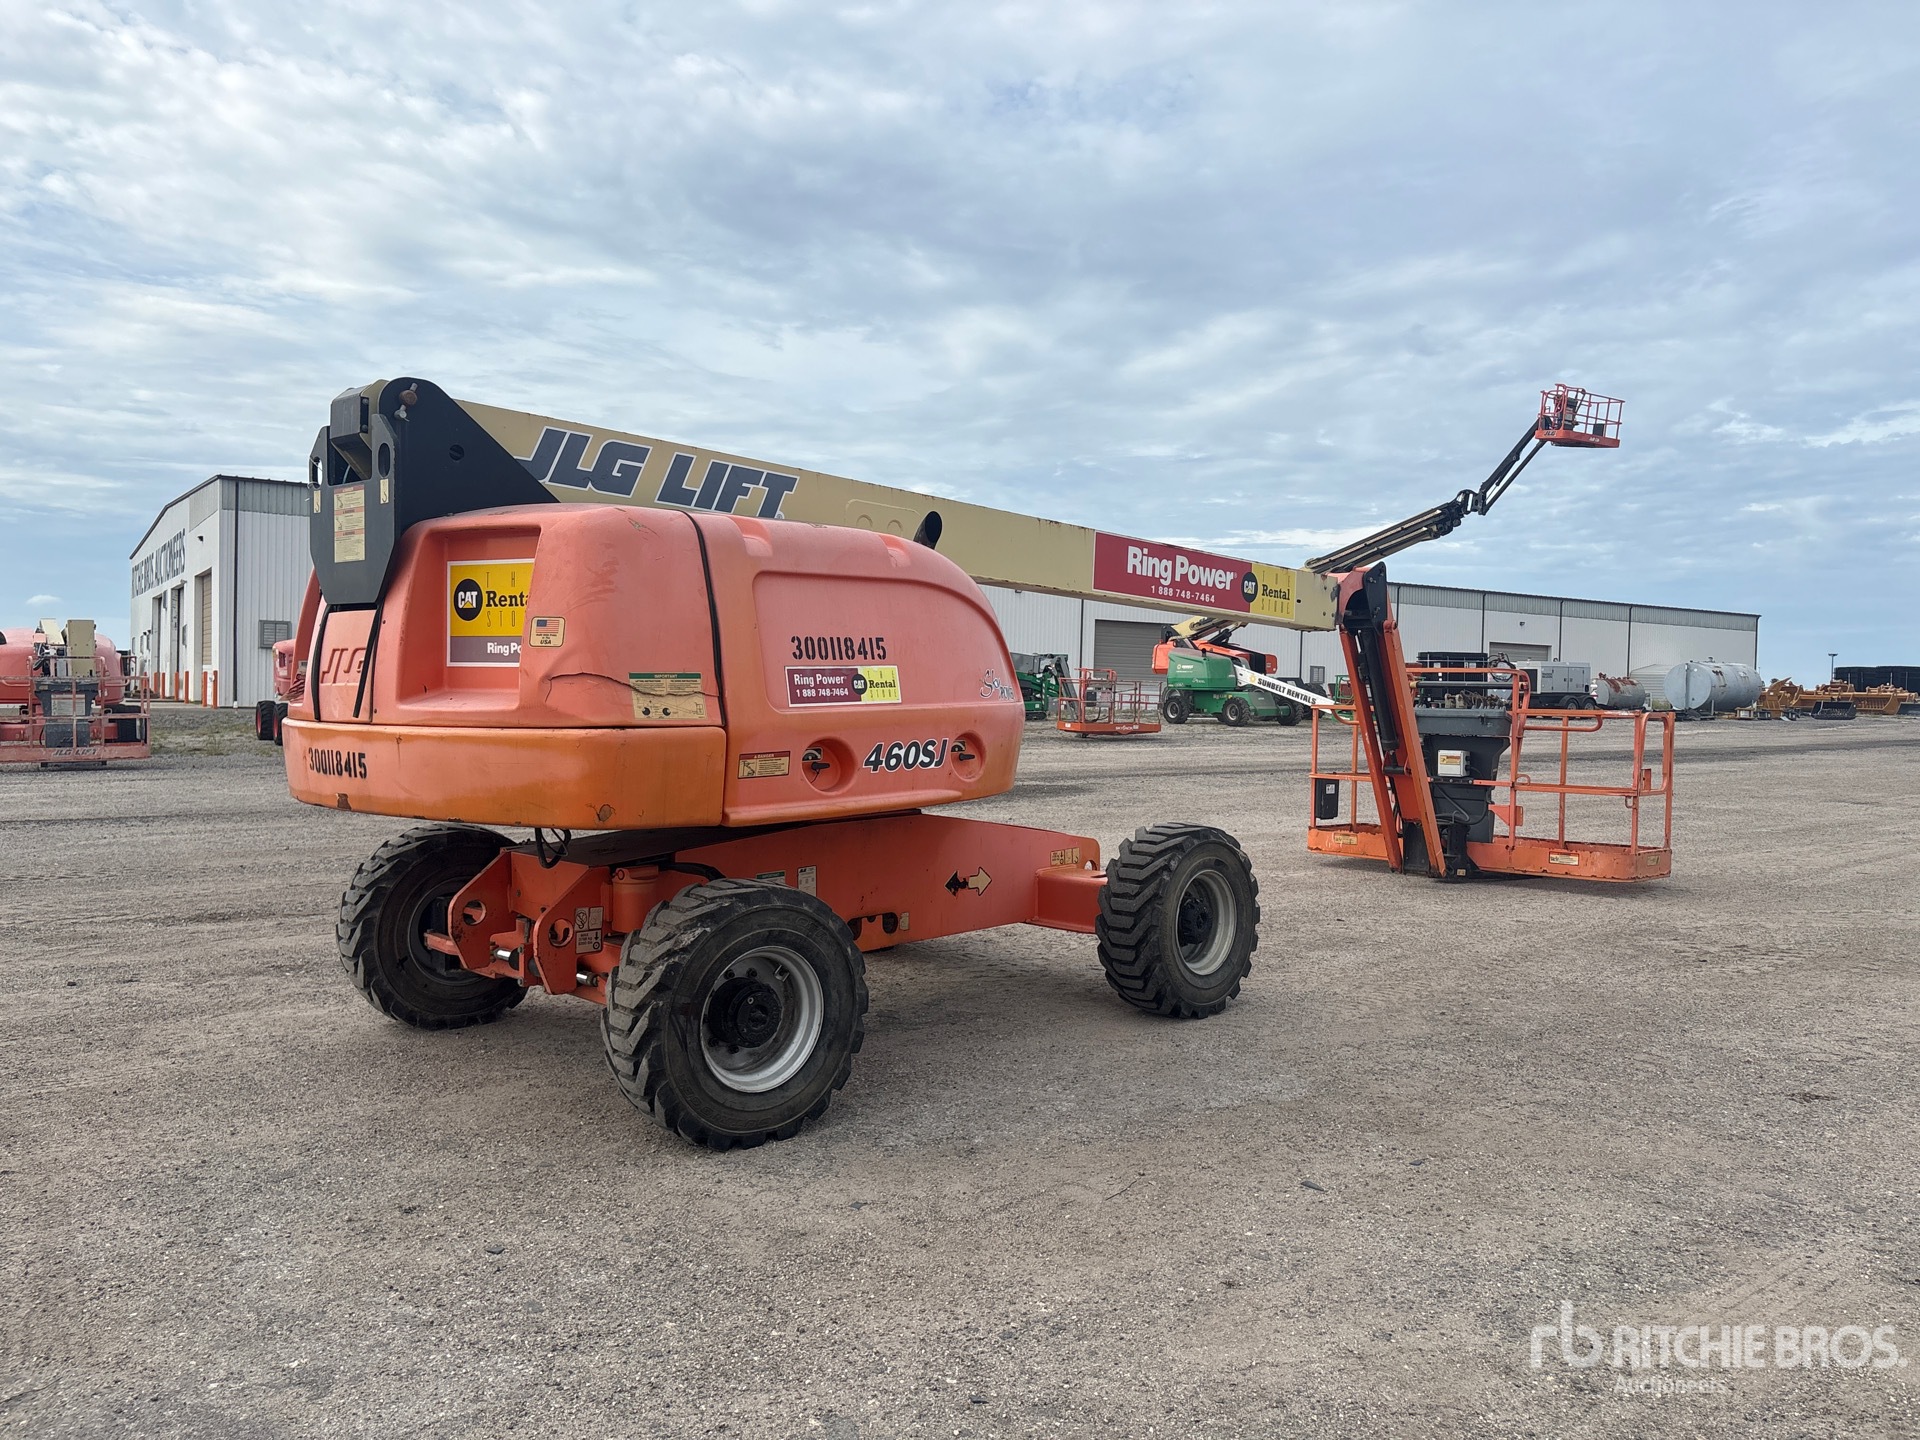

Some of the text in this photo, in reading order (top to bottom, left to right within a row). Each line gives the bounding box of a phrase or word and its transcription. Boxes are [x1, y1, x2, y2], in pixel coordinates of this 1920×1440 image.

[513, 426, 799, 518] JLG LIFT
[1127, 545, 1234, 590] Ring Power
[1151, 585, 1215, 603] 1 888 748-7464
[1243, 580, 1256, 595] CAT
[1261, 583, 1290, 600] Rental
[458, 591, 478, 609] CAT
[487, 642, 510, 656] Ring
[790, 635, 887, 660] 300118415
[794, 673, 845, 687] Ring Power
[853, 680, 865, 689] CAT
[869, 680, 896, 689] Rental
[796, 687, 849, 698] 1 888 748-7464
[1257, 678, 1317, 704] SUNBELT RENTALS
[308, 747, 368, 779] 300118415
[863, 738, 949, 773] 460SJ
